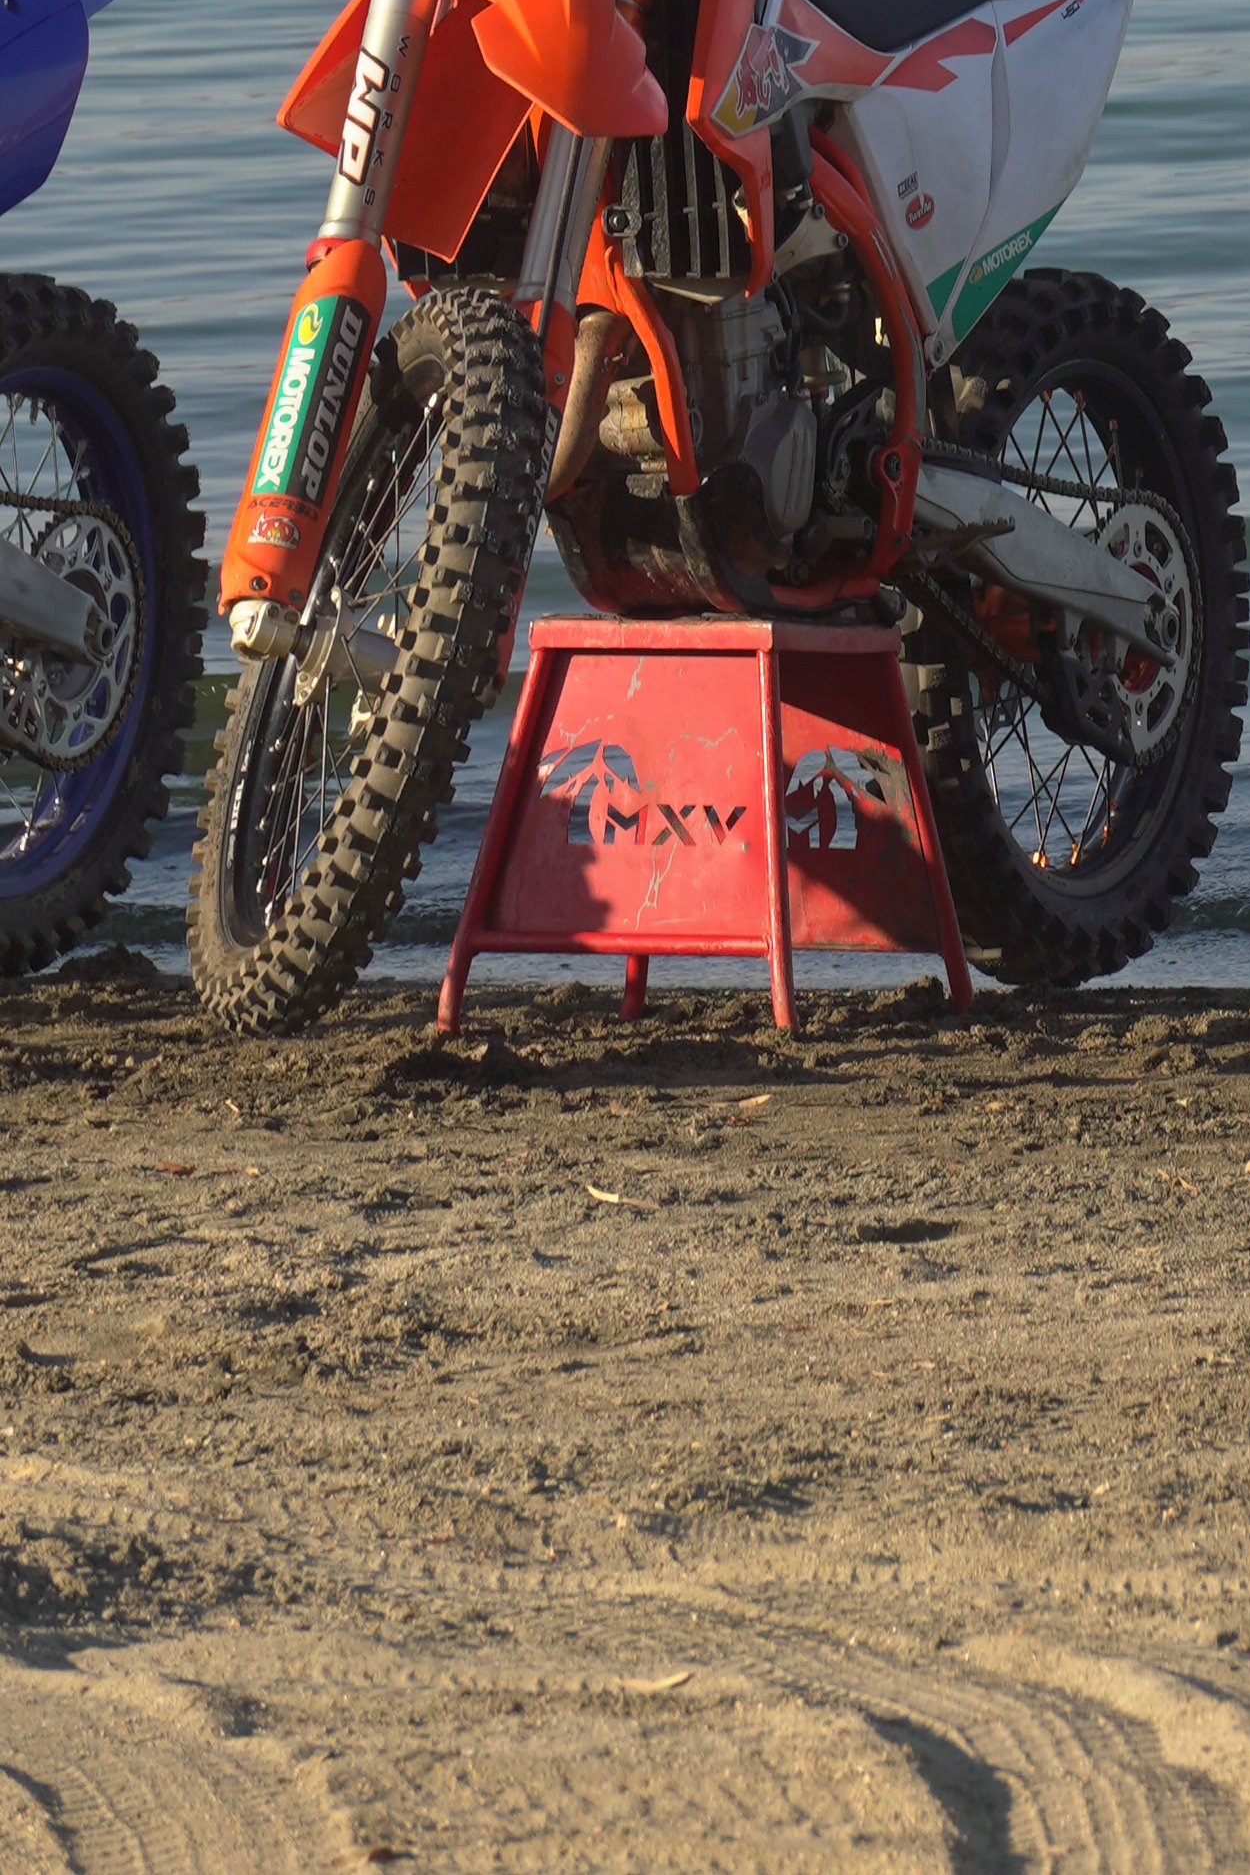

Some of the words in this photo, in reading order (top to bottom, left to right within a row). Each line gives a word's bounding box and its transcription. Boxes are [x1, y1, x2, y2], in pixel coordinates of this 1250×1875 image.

[338, 46, 390, 186] WP
[363, 34, 410, 206] WORKS
[981, 230, 1033, 276] MOTOREX
[257, 346, 316, 491] MOTOREX
[300, 304, 363, 502] DUNLOP
[603, 803, 747, 846] MXV
